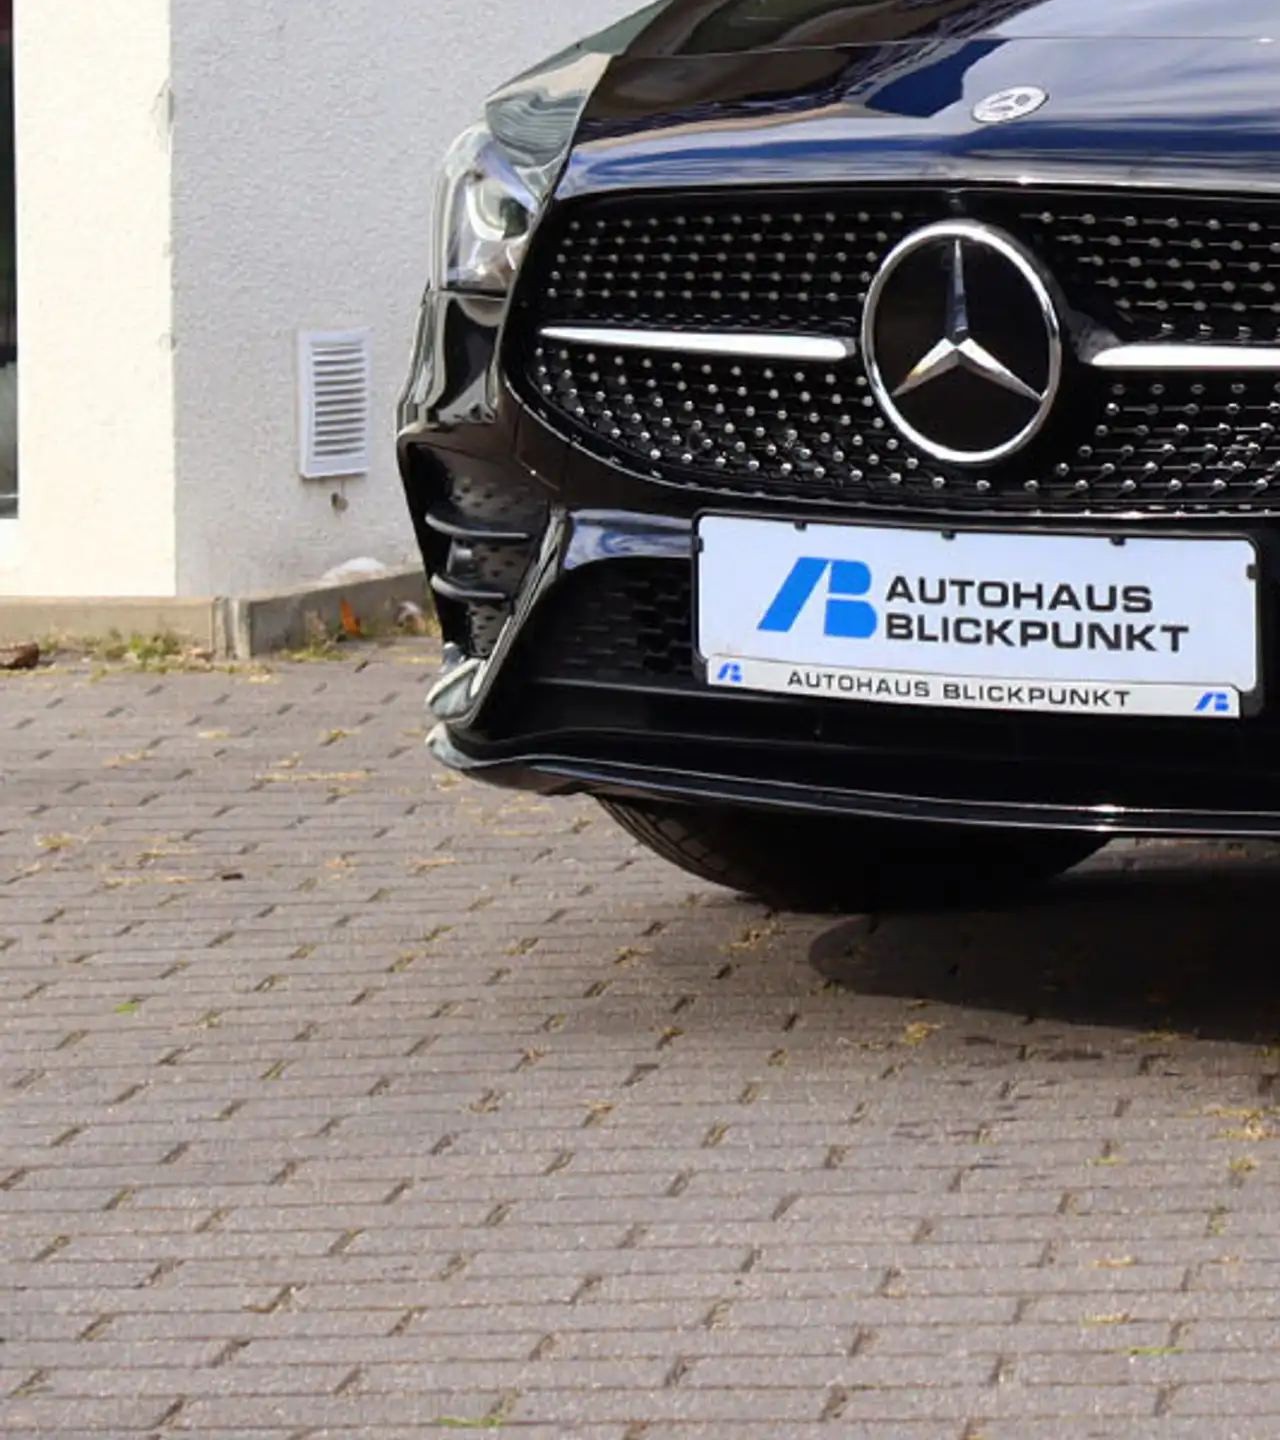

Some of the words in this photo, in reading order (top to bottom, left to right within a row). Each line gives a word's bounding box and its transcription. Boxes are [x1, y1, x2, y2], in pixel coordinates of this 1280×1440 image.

[885, 574, 1154, 614] AUTOHAUS
[885, 611, 1190, 654] BLICKPUNKT
[786, 669, 931, 699] AUTOHAUS
[942, 682, 1131, 709] BLICKPUNKT
